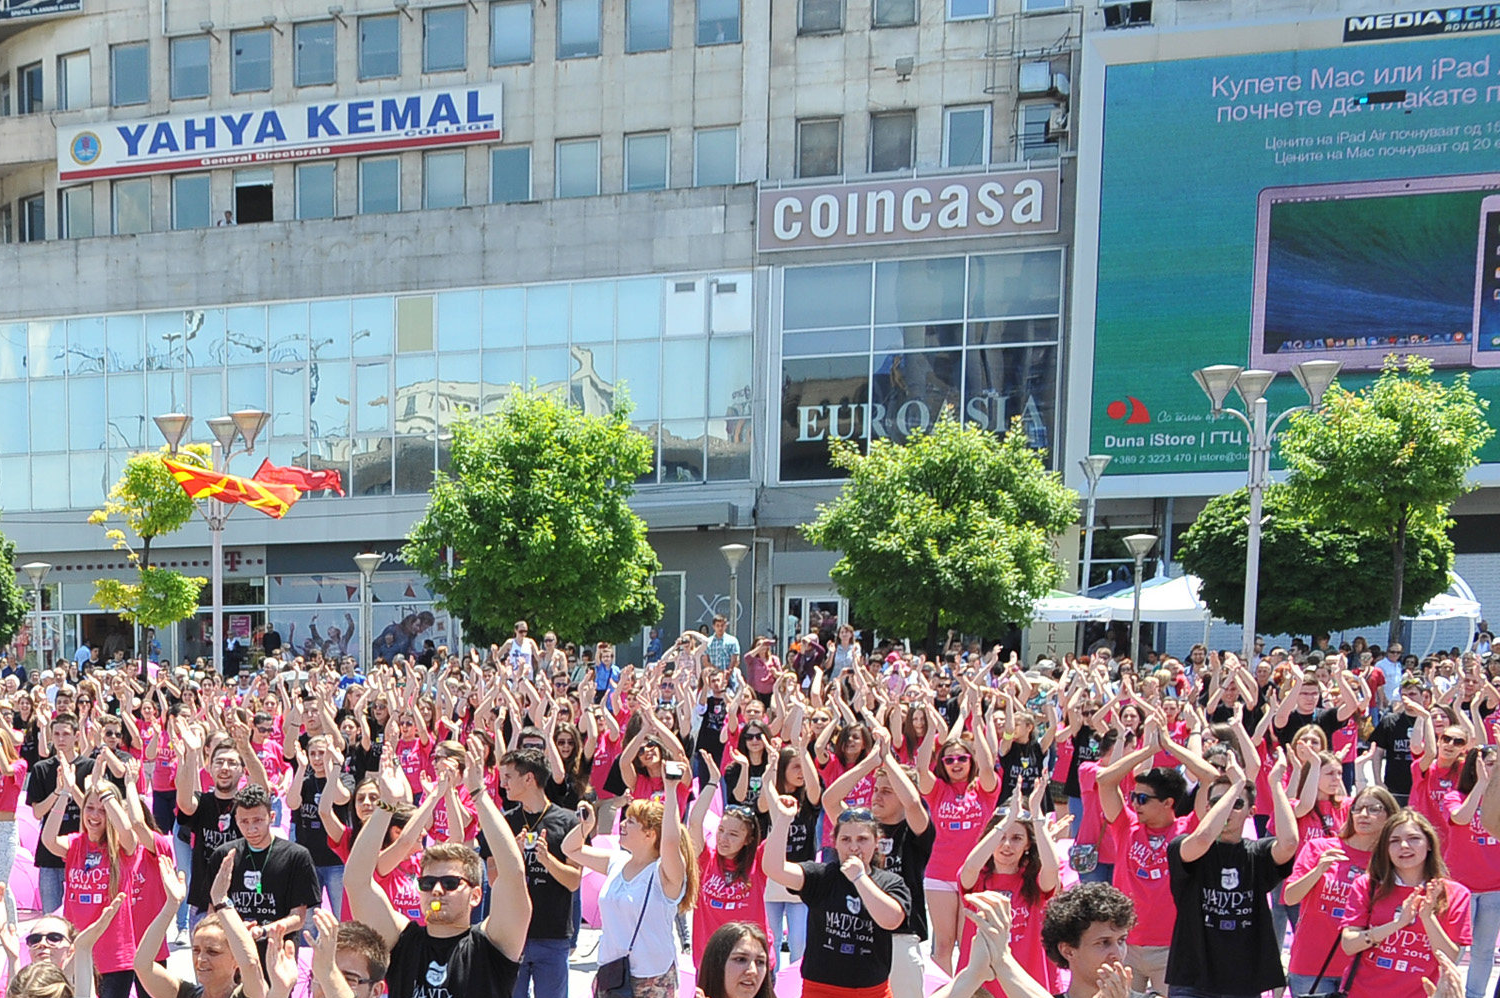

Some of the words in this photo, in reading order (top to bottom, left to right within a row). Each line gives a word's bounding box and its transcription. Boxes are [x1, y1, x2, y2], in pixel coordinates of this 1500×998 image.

[1348, 11, 1443, 31] MEDIA
[1211, 74, 1302, 100] Купете
[1311, 66, 1365, 90] Mac
[1374, 65, 1423, 86] или
[1431, 54, 1490, 82] iPad
[1216, 98, 1322, 122] почнете
[116, 110, 288, 157] YAHYA
[306, 90, 495, 139] KEMAL
[404, 122, 495, 138] COLLEGE
[200, 153, 253, 167] General
[255, 146, 332, 162] Directorate
[773, 178, 1045, 241] coincasa
[1105, 435, 1145, 449] Duna
[1149, 433, 1196, 447] iStore
[1209, 431, 1242, 446] ГТЦ
[224, 551, 241, 572] T
